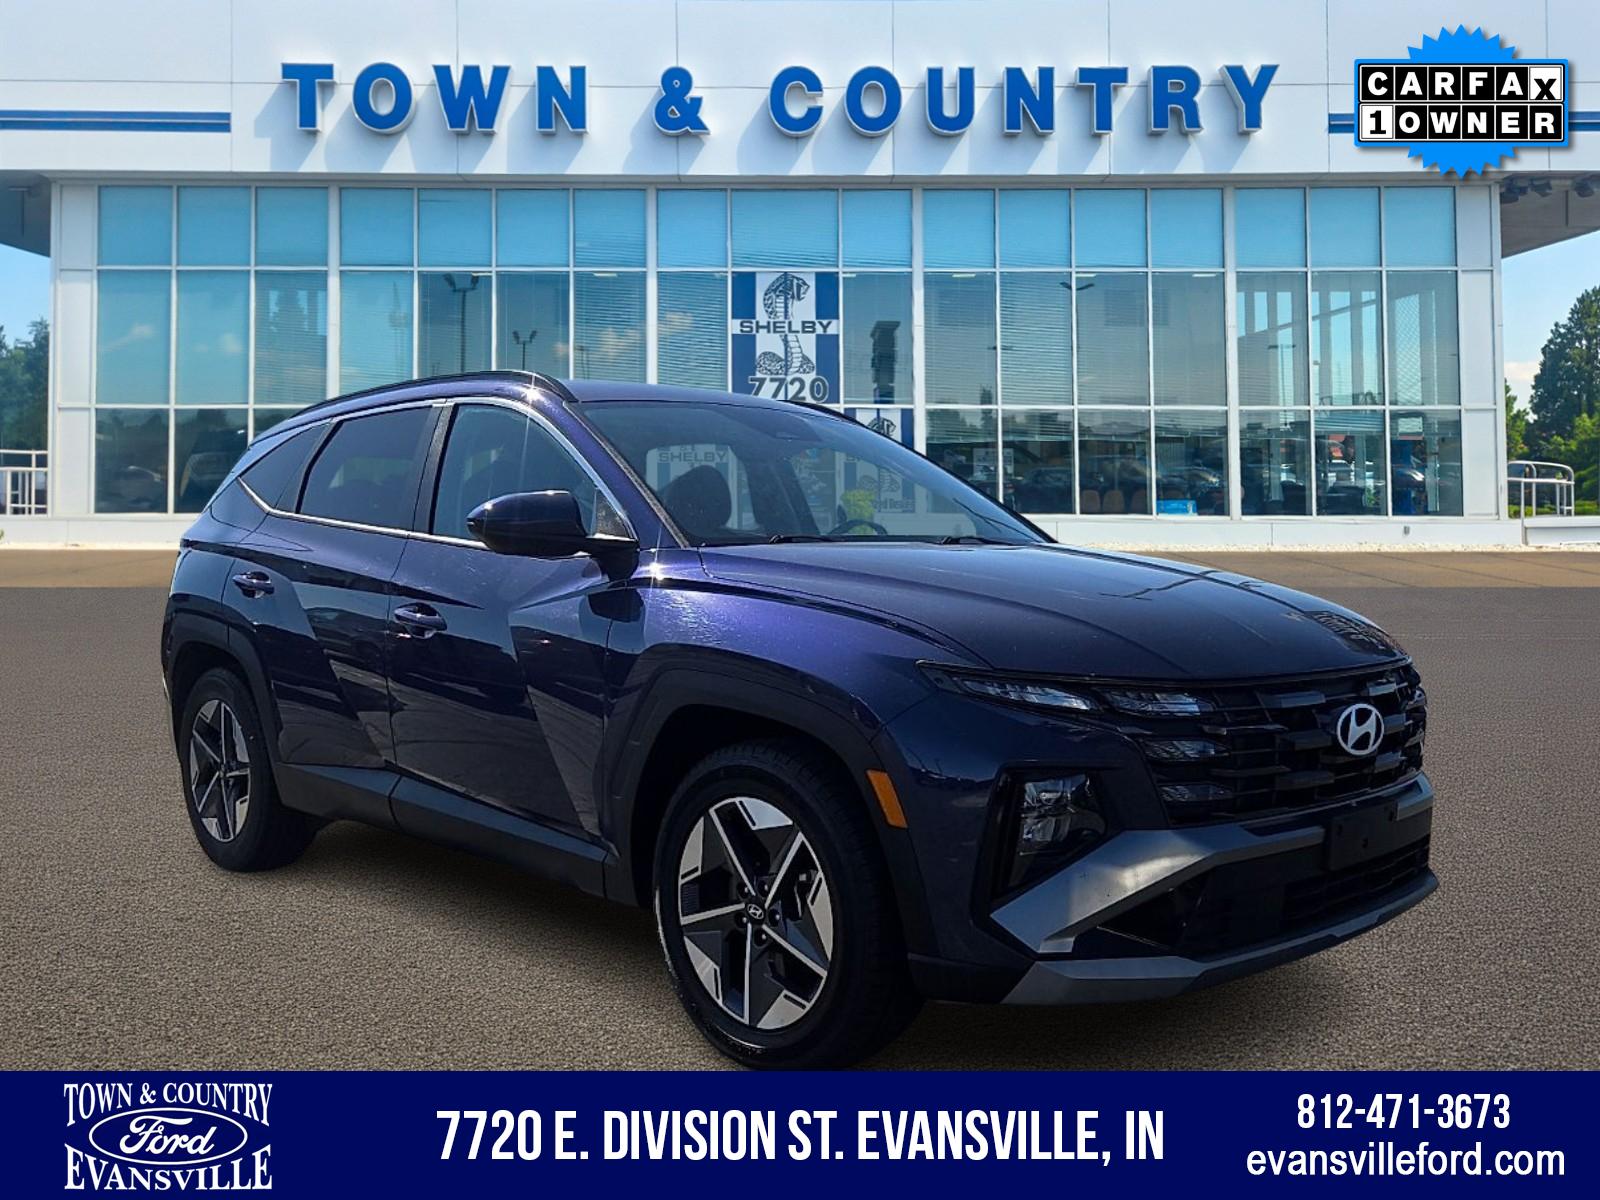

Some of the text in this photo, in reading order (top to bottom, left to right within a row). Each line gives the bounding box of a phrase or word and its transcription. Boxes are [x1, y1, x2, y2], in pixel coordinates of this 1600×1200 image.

[281, 62, 1280, 137] TOWN & COUNTRY
[739, 320, 833, 334] SHELBY
[748, 376, 829, 403] 7720
[659, 452, 727, 462] SHELBY
